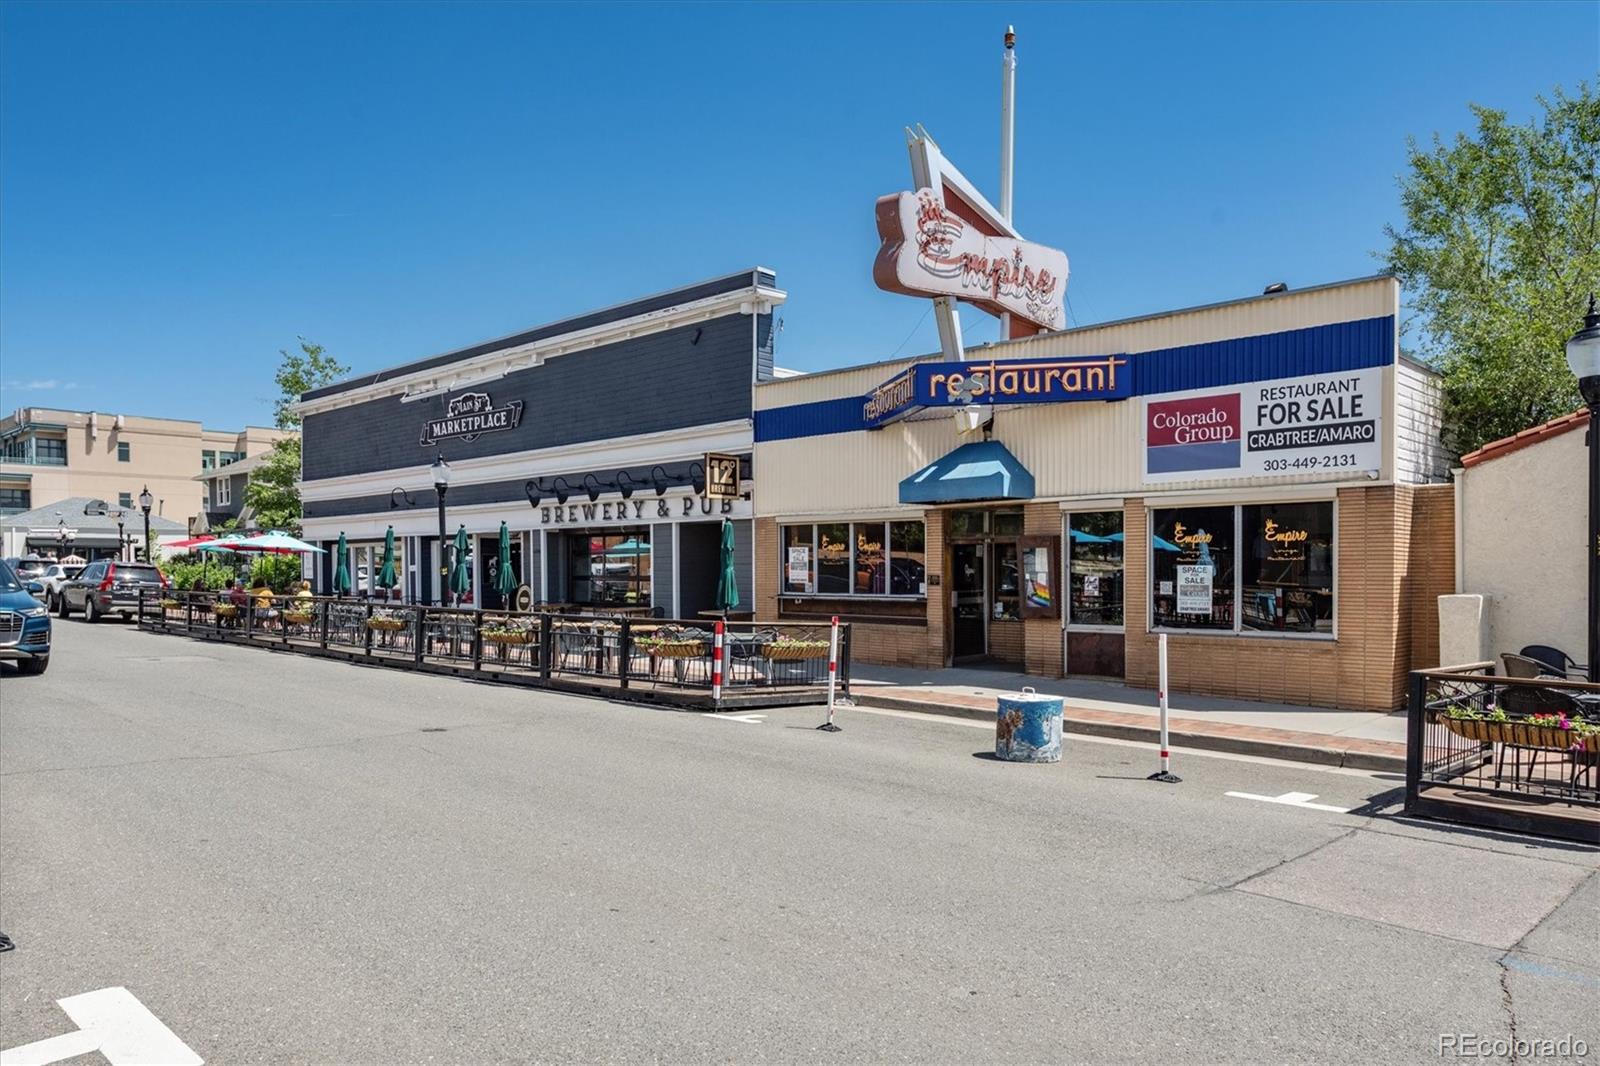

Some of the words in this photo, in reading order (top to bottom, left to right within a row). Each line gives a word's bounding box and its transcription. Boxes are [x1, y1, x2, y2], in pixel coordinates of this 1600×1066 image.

[914, 198, 1057, 304] Empire
[930, 356, 1127, 397] restaurant
[1260, 378, 1361, 401] RESTAURANT
[1153, 408, 1228, 429] Colorado
[1257, 401, 1302, 427] FOR
[1306, 394, 1363, 422] SALE
[432, 411, 507, 437] MARKETPLACE
[1175, 425, 1234, 444] Group
[1249, 424, 1374, 448] CRABTREE/AMARO
[1263, 454, 1357, 471] 303-449-2131
[541, 501, 643, 524] BREWERY
[657, 499, 670, 517] &
[683, 497, 733, 516] PUB
[1175, 522, 1213, 549] Empire
[1265, 519, 1308, 547] Empire
[1182, 566, 1208, 574] SPACE
